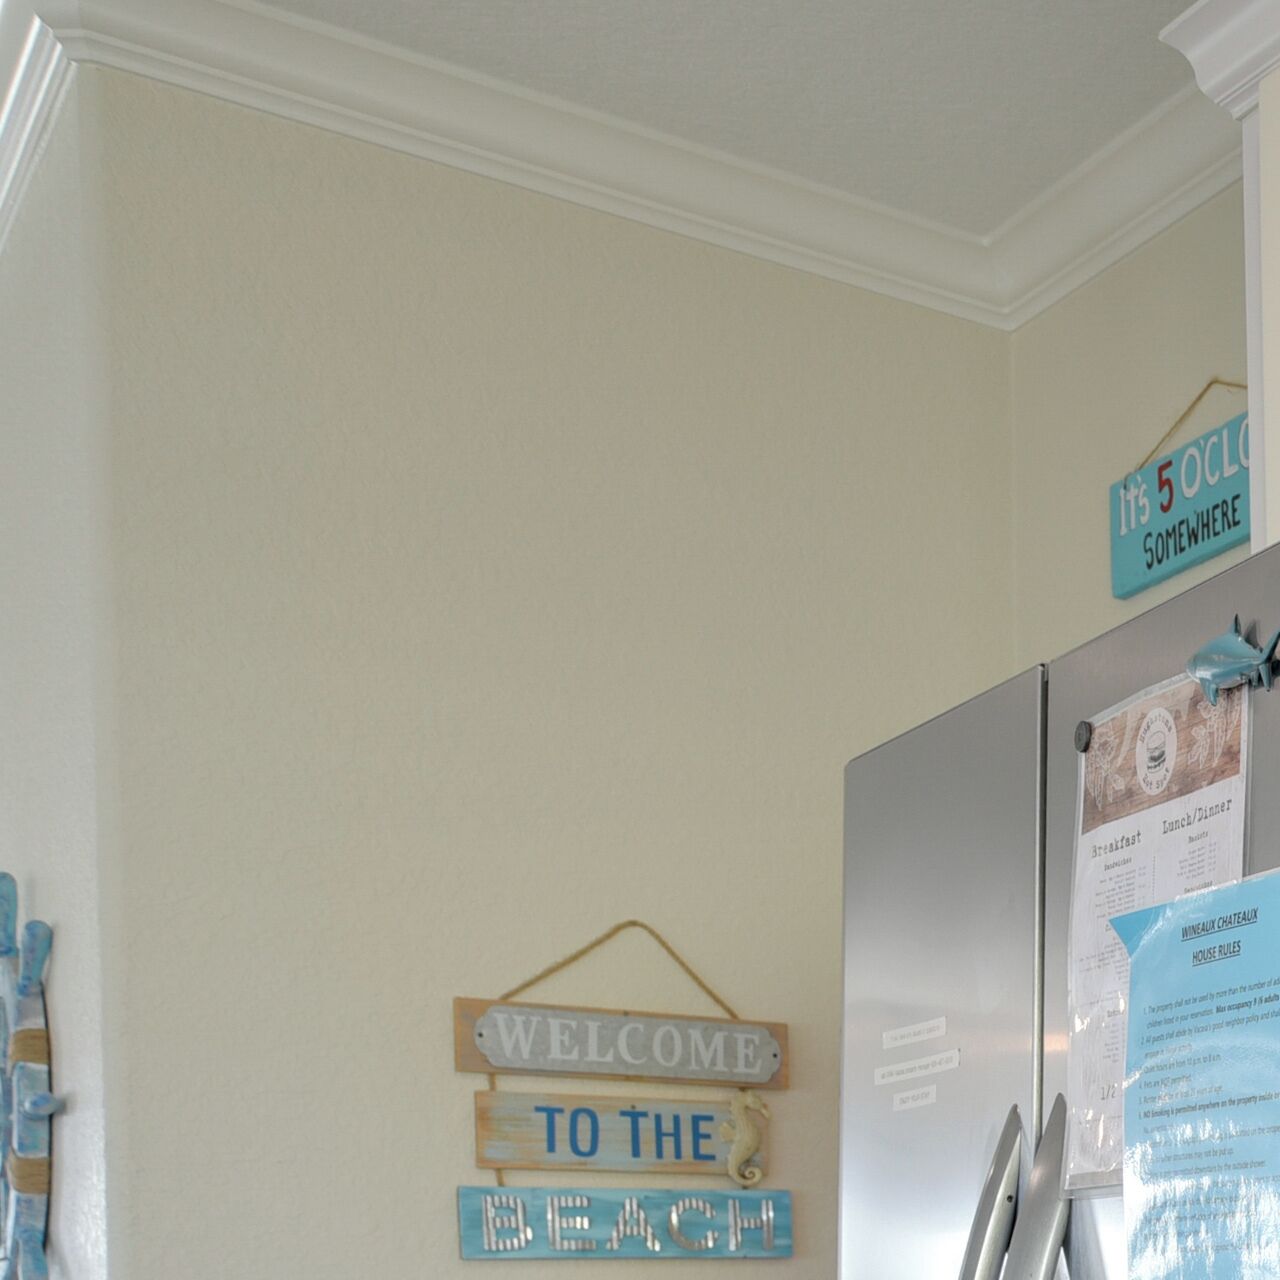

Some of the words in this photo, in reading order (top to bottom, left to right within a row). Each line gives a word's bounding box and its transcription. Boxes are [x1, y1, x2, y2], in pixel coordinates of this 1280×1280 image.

[1157, 460, 1174, 513] 5
[1143, 494, 1241, 570] SOMEWHERE
[1162, 799, 1232, 835] Lunch/Dinner
[1090, 829, 1141, 859] Breakfast
[1181, 918, 1216, 939] WINEAUX
[1217, 906, 1258, 929] CHATEAUX
[1192, 945, 1216, 964] HOUSE
[1218, 940, 1241, 957] RULES
[493, 1012, 763, 1075] WELCOME
[534, 1105, 599, 1157] TO
[619, 1110, 716, 1162] THE
[482, 1195, 774, 1252] BEACH
